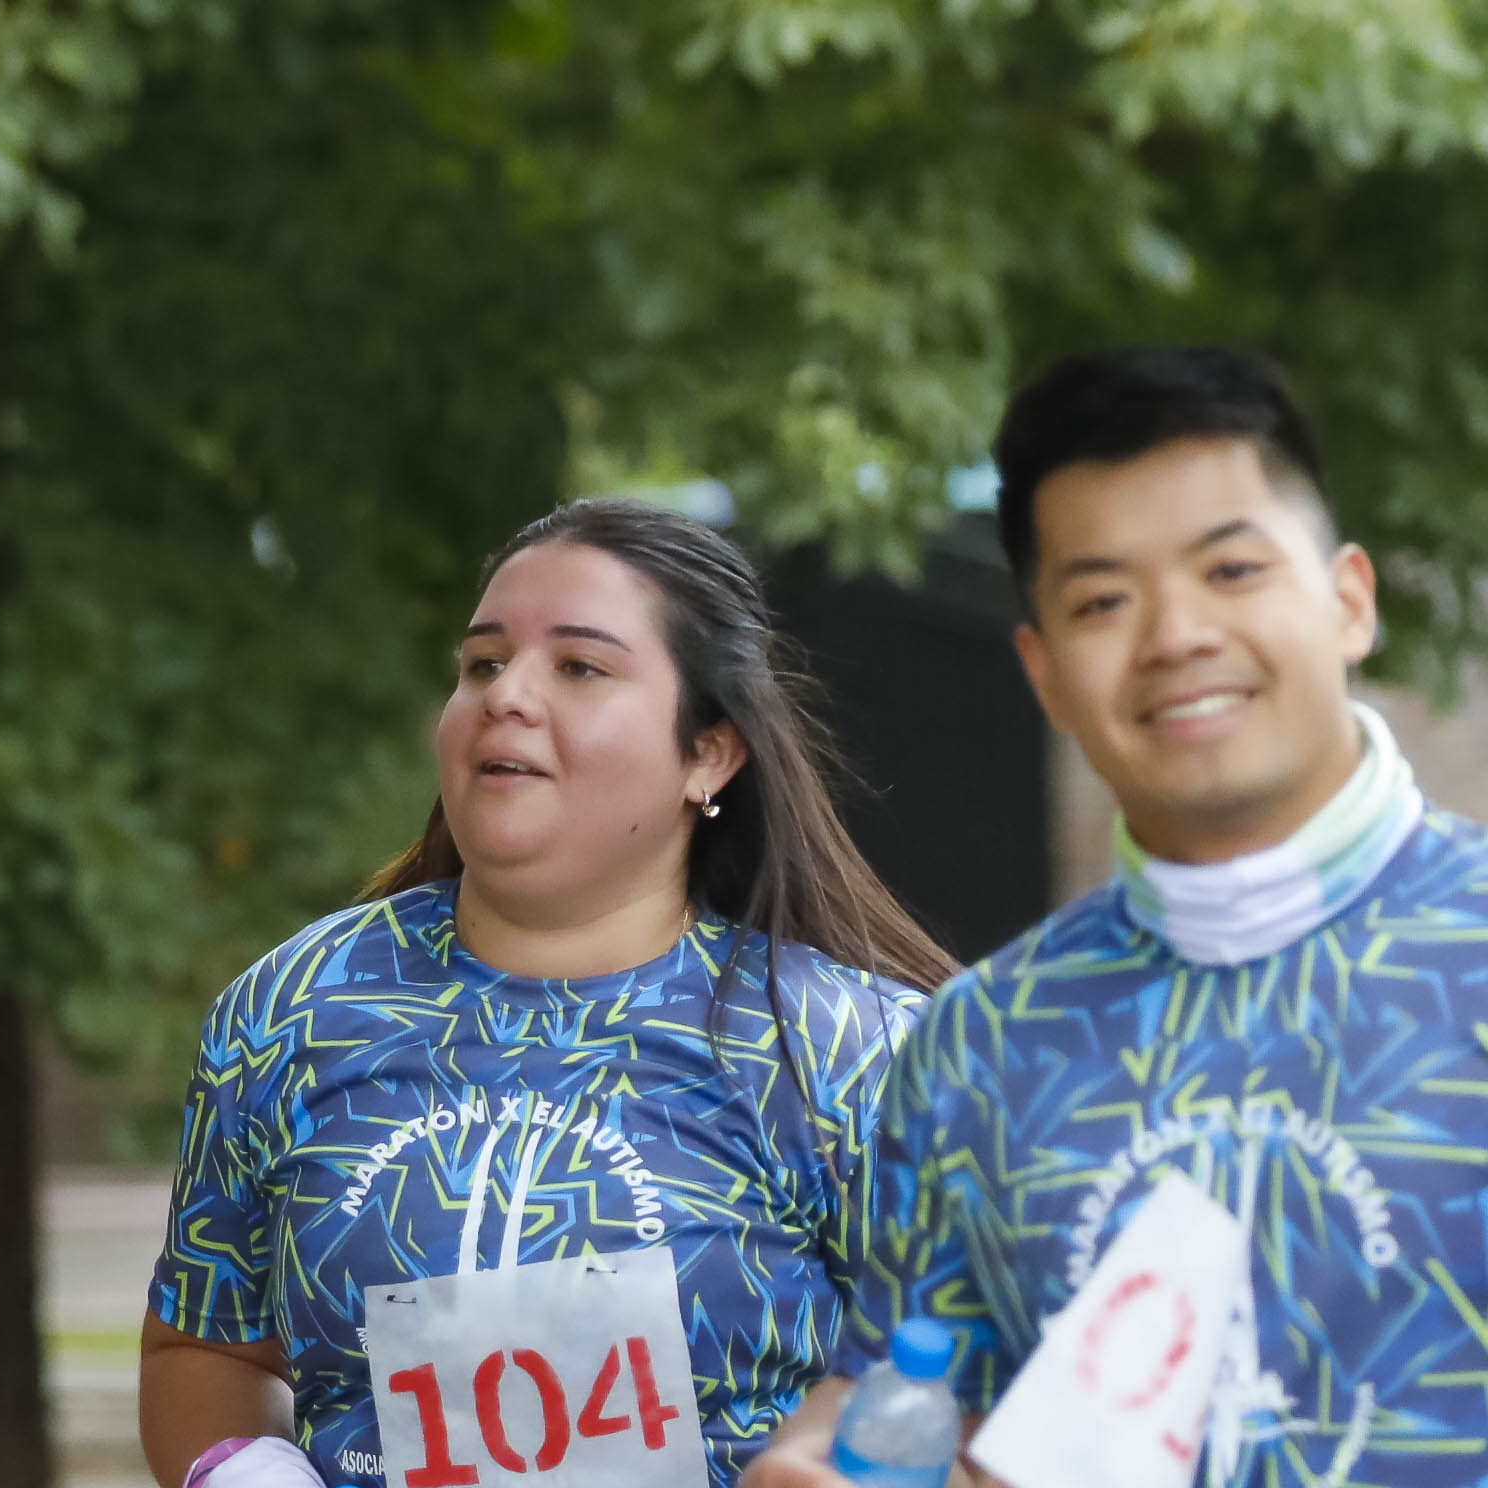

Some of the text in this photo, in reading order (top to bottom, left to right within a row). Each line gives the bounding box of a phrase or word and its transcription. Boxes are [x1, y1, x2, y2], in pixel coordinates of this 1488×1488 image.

[340, 1096, 665, 1242] MARATÓN X EL AUTISMO
